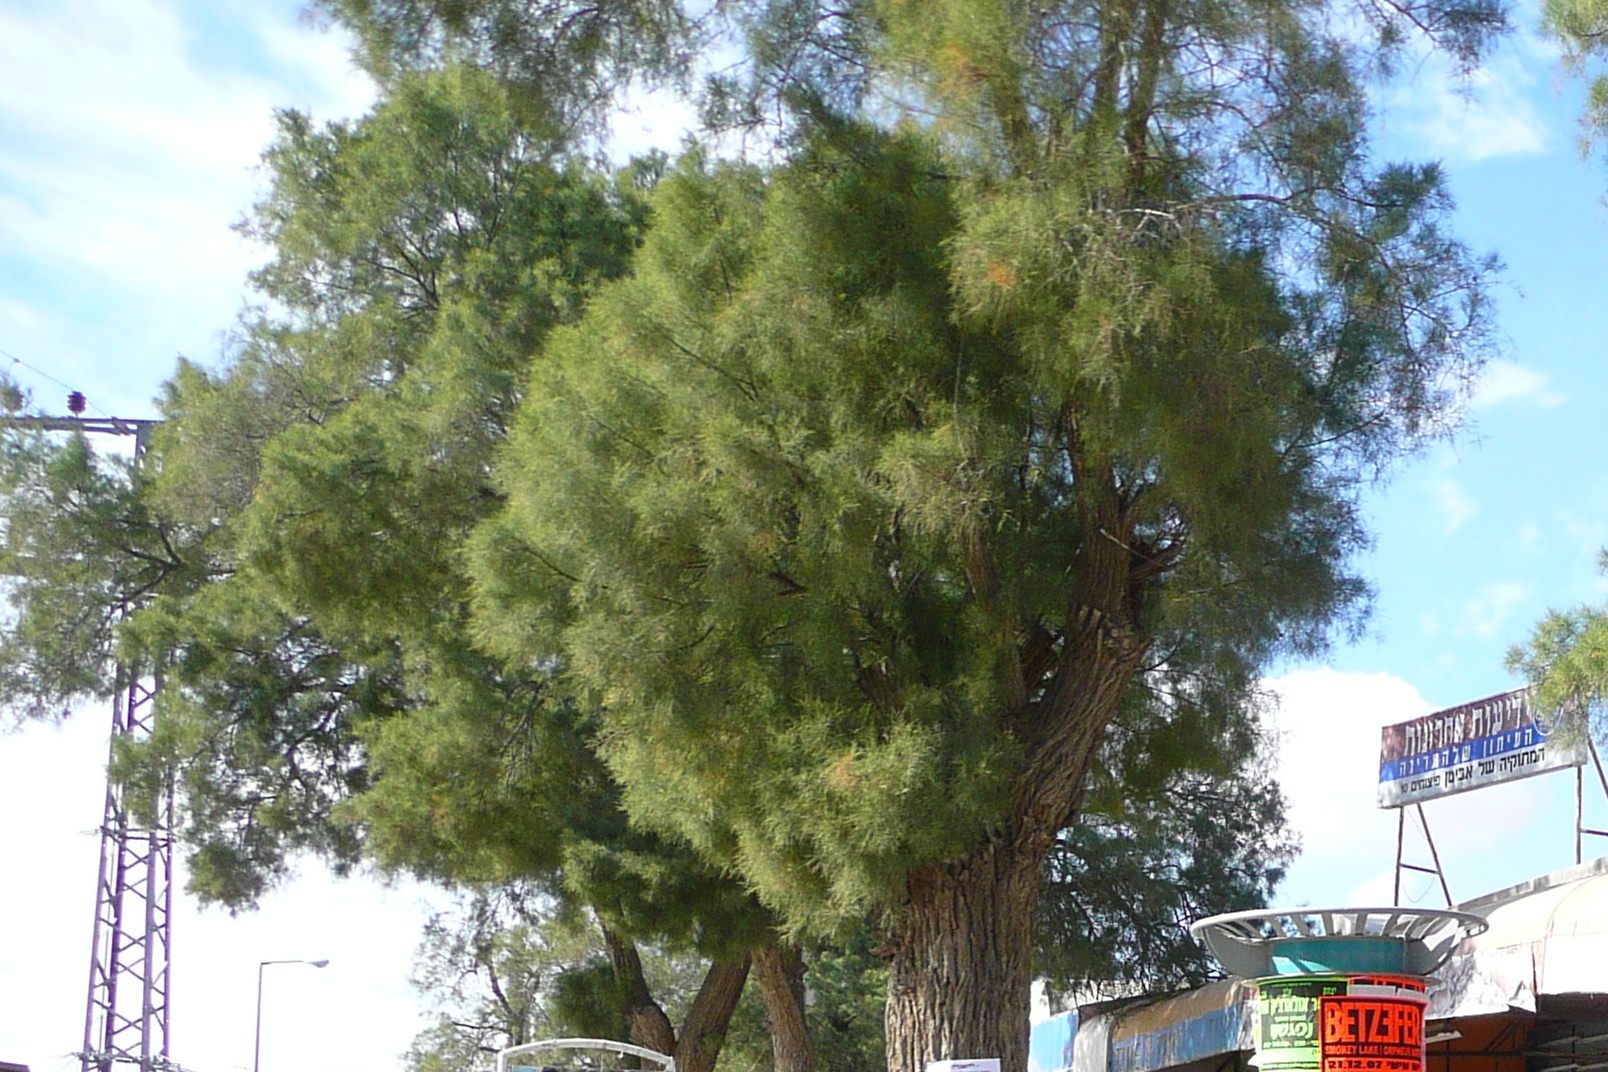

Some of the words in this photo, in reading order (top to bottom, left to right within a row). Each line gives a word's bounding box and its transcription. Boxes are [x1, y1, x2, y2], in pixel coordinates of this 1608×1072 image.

[1403, 713, 1466, 757] אחרונות
[1478, 760, 1495, 777] של
[1324, 1045, 1357, 1055] SMOKEY
[1360, 1045, 1379, 1055] LAKE
[1327, 1060, 1383, 1069] 21.12.07
